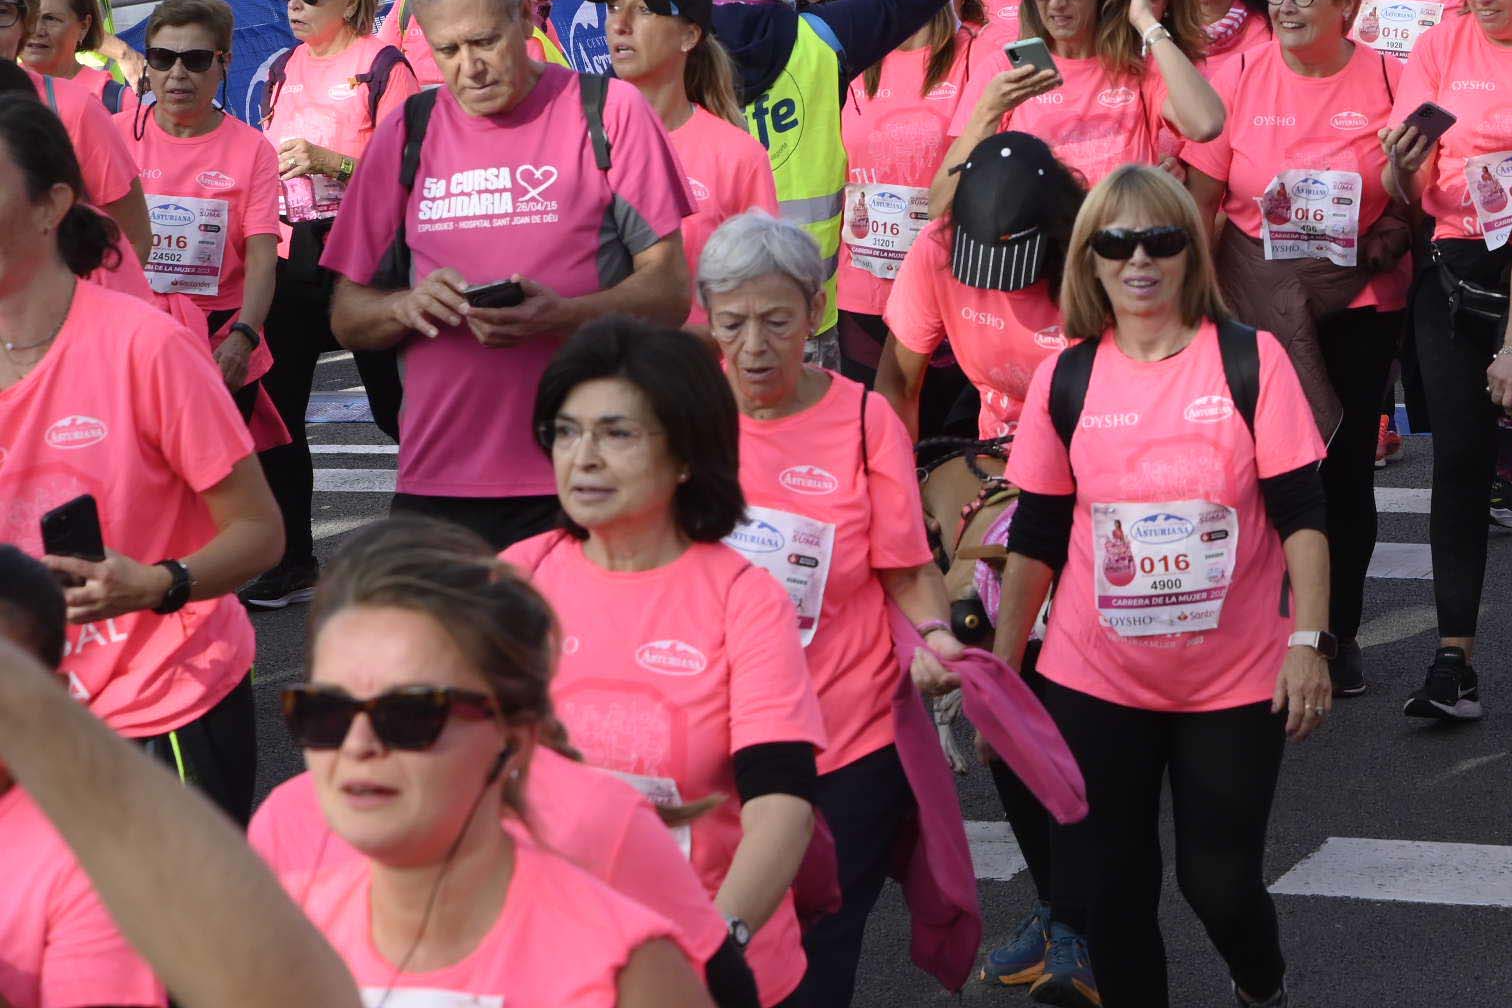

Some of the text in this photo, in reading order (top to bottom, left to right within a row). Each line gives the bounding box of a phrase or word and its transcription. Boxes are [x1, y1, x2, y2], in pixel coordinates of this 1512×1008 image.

[1382, 26, 1410, 39] 016
[1451, 79, 1496, 91] OYSHO
[1253, 115, 1296, 127] OYSHO
[450, 166, 513, 195] CURSA
[417, 190, 514, 221] SOLIDÀRIA
[458, 219, 491, 230] HOSPITAL
[492, 217, 511, 227] SANT
[511, 215, 531, 226] JOAN
[531, 215, 542, 224] DE
[871, 219, 900, 236] 016
[872, 236, 896, 248] 31201
[152, 251, 182, 262] 24502
[960, 306, 1005, 331] OYSHO
[1081, 412, 1140, 429] OYSHO
[1136, 526, 1189, 537] ASTURIANA
[1140, 553, 1190, 574] 016
[1150, 578, 1182, 591] 4900
[1111, 593, 1207, 607] CARRERA DE LA MUJER
[1108, 615, 1153, 627] OYSHO
